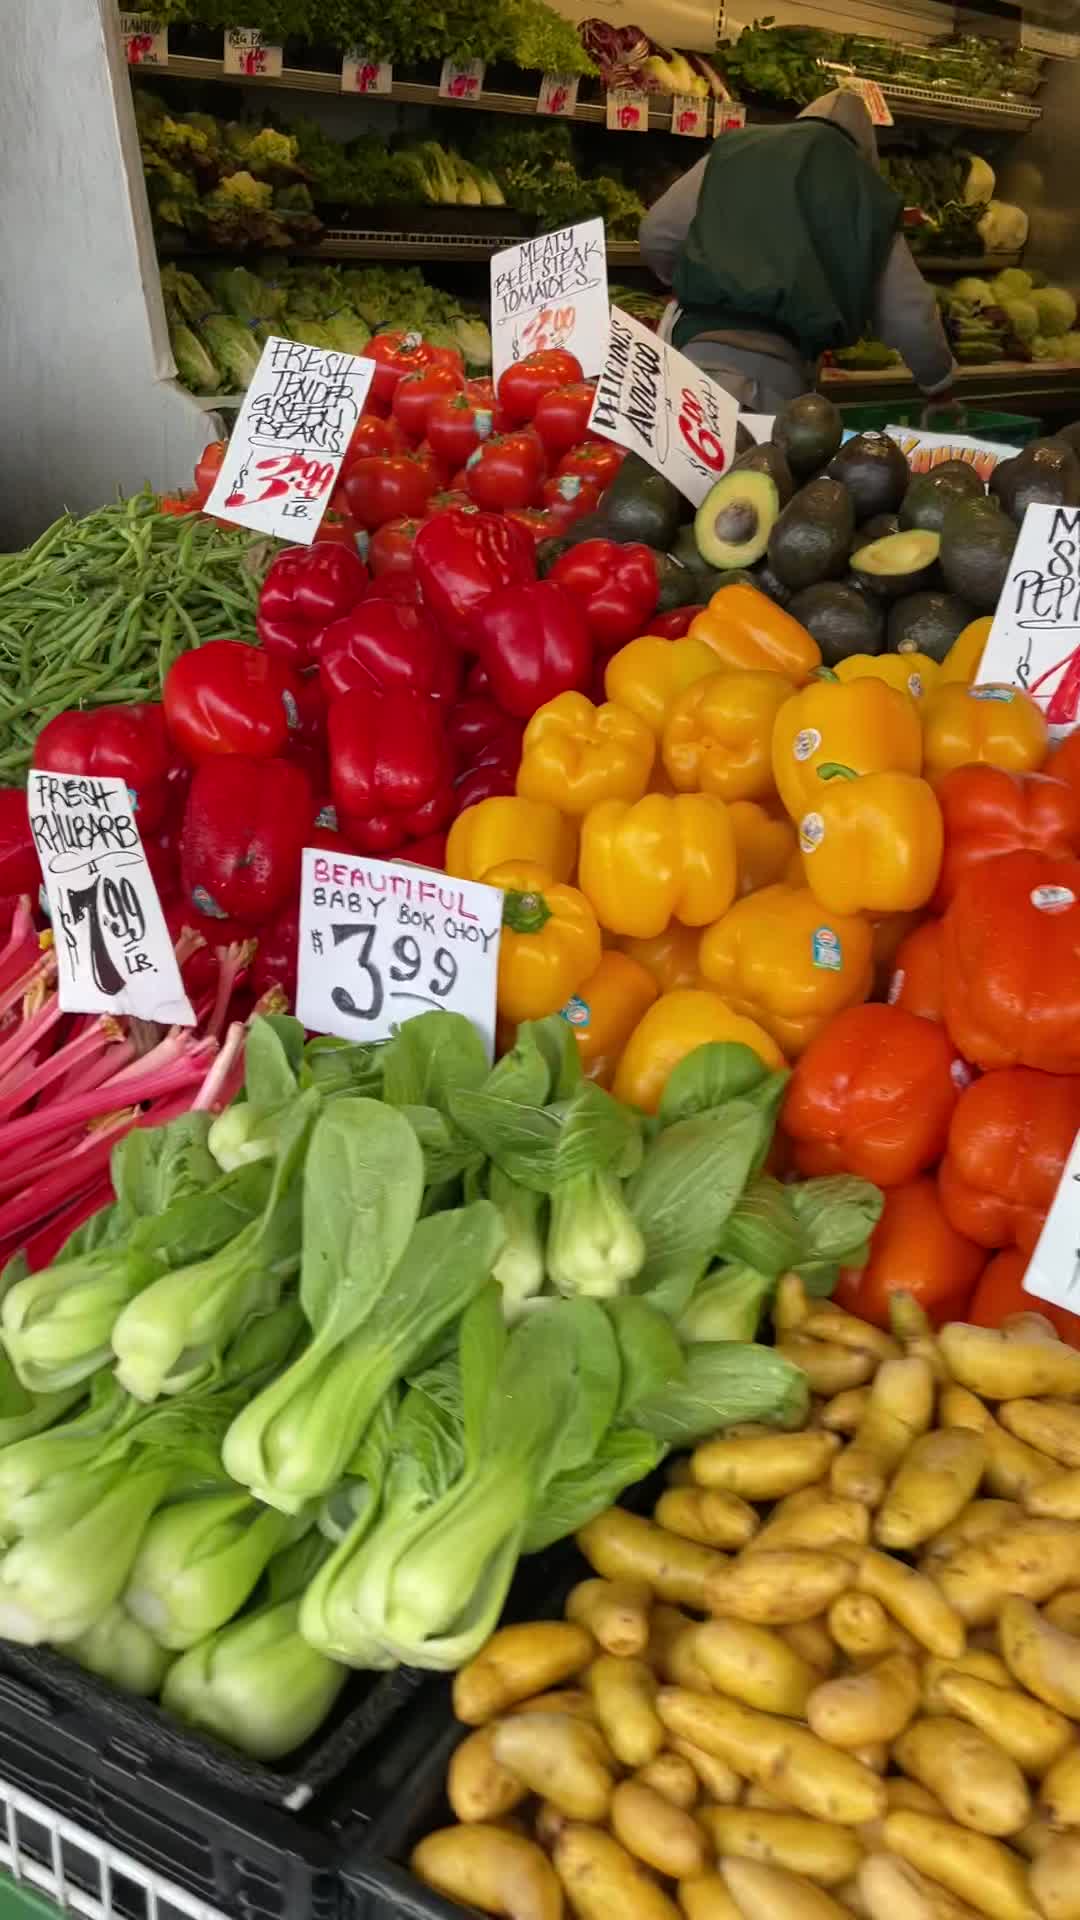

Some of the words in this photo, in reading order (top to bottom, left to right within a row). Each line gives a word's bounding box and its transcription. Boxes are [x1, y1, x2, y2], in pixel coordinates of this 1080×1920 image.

[495, 240, 604, 298] BEEFSTEAK
[520, 229, 574, 264] MEATY
[500, 267, 588, 312] TOMATOES
[271, 341, 364, 383] FRESH
[593, 320, 633, 430] DELICIOUS
[252, 393, 344, 429] GREEN
[272, 371, 357, 418] TENDER
[622, 342, 661, 448] AVOCADO
[248, 414, 344, 452] BEANS
[35, 775, 118, 813] FRESH
[31, 810, 139, 854] RHUBARB
[314, 858, 479, 921] BEAUTIFUL
[313, 887, 386, 919] BABY
[397, 903, 435, 935] BOK
[444, 917, 499, 953] CHOY
